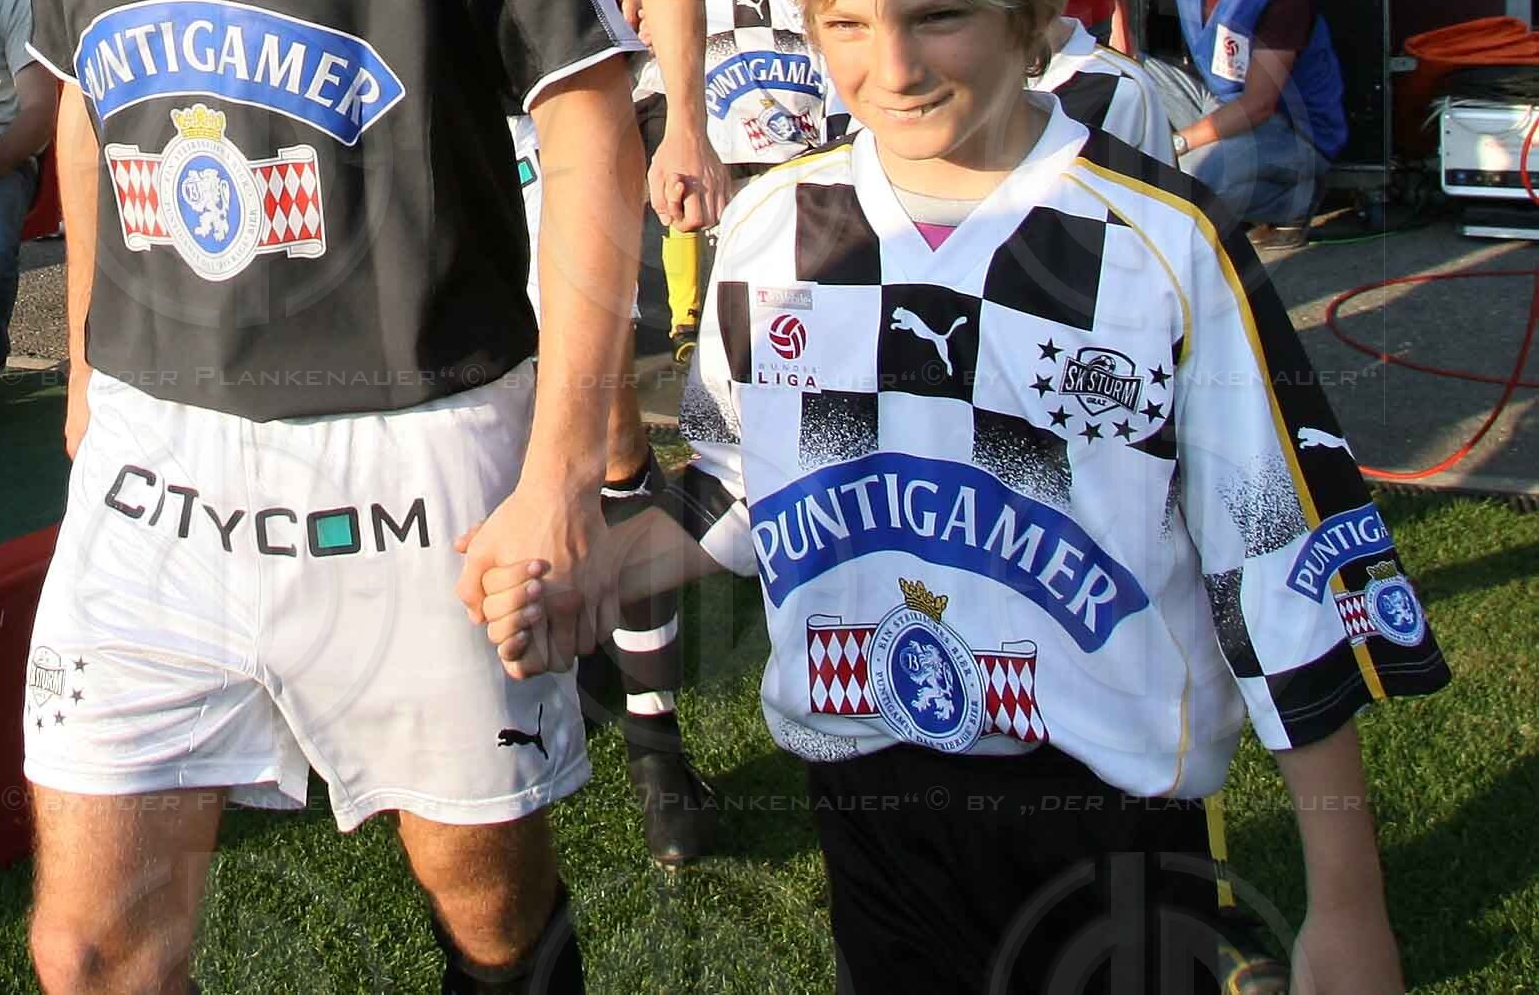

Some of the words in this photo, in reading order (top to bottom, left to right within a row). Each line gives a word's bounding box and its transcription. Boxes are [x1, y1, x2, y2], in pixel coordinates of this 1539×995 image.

[757, 372, 817, 389] LIGA
[1065, 365, 1088, 392] SK
[1088, 372, 1137, 407] STURM
[104, 463, 430, 558] CITYCOM
[751, 472, 1118, 634] PUNTIGAMER
